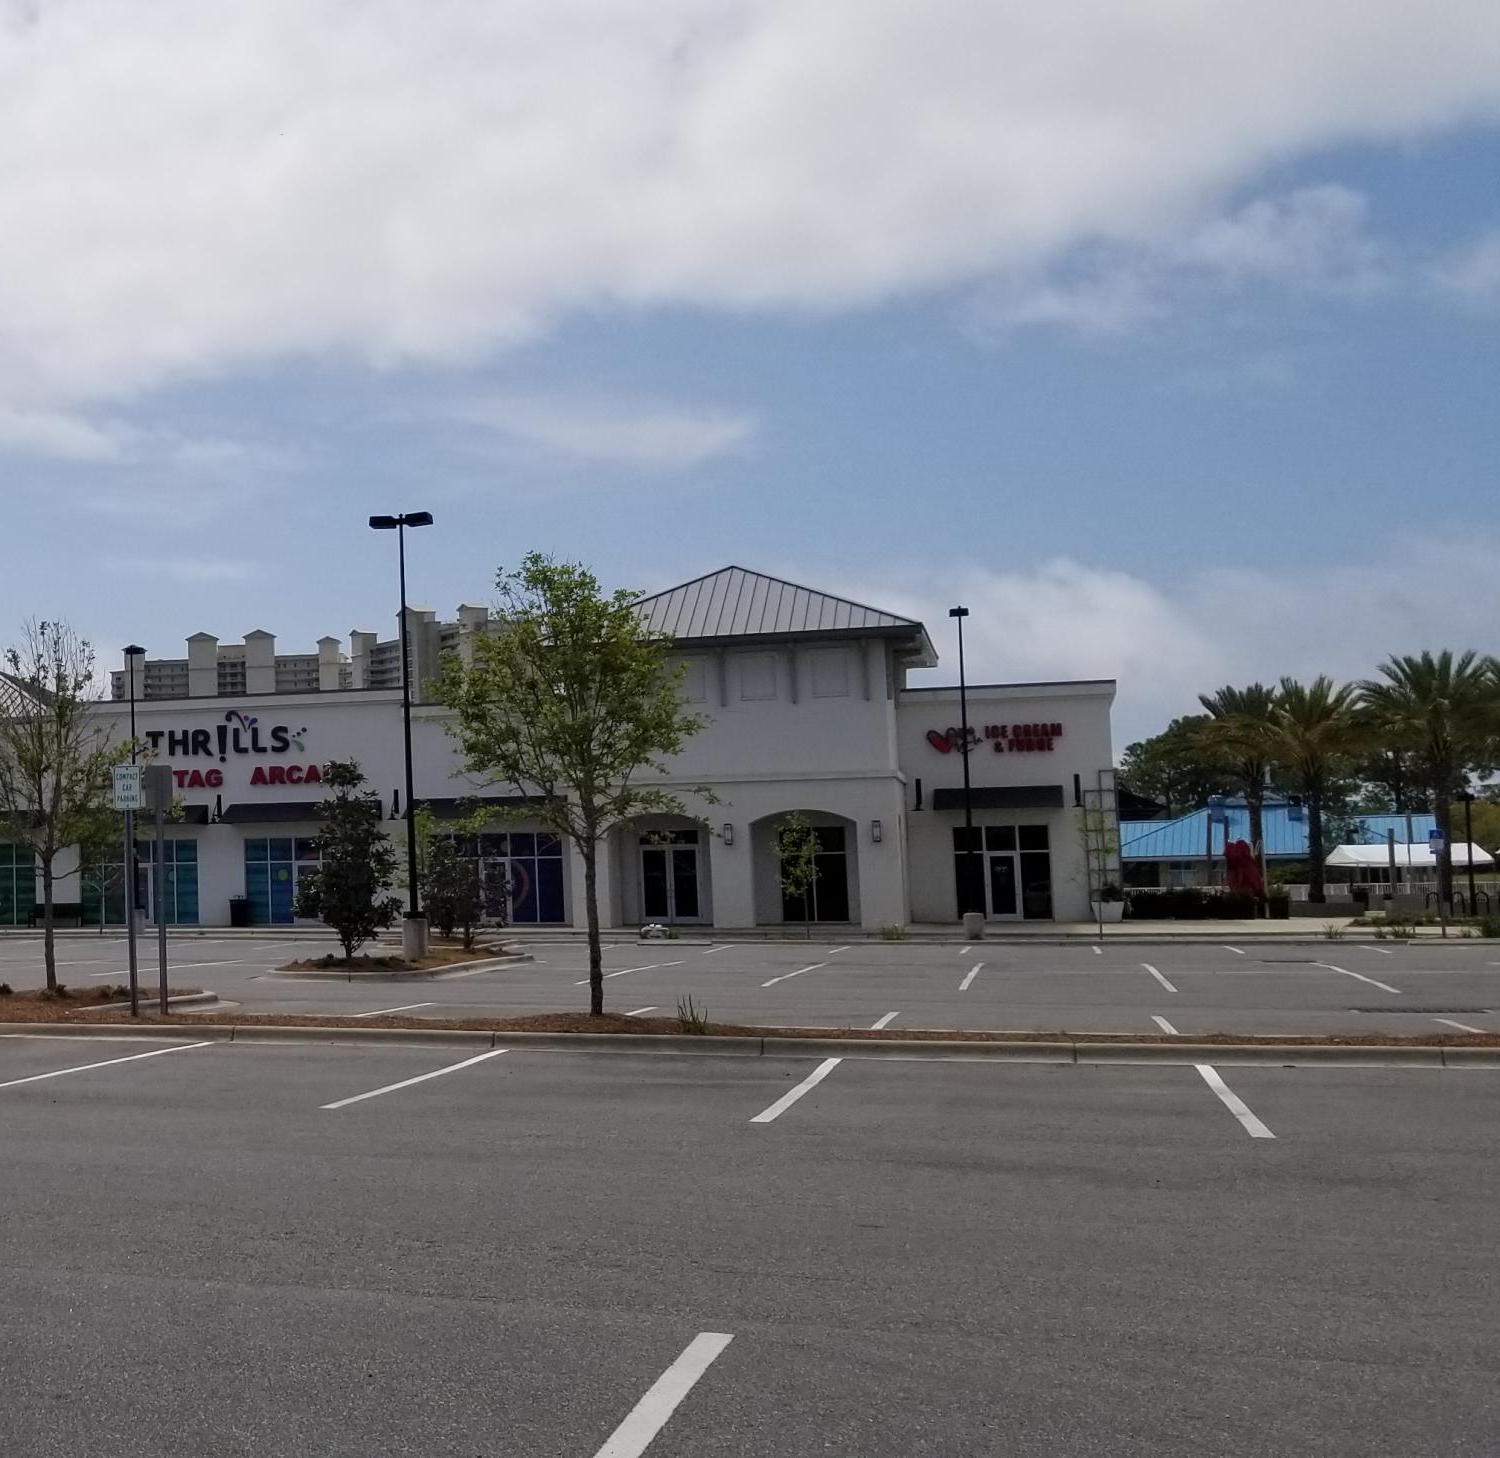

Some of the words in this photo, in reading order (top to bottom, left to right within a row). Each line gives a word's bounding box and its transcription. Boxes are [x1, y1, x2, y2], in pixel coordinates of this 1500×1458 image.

[985, 725, 1008, 739] ICE
[1012, 723, 1062, 736] CREAM
[994, 741, 1004, 752] &
[1008, 738, 1054, 752] FUDGE
[116, 773, 138, 781] COMPACT
[173, 769, 224, 788] TAG
[250, 765, 331, 785] ARCA
[122, 783, 132, 792] CAR
[117, 794, 138, 802] PARKING
